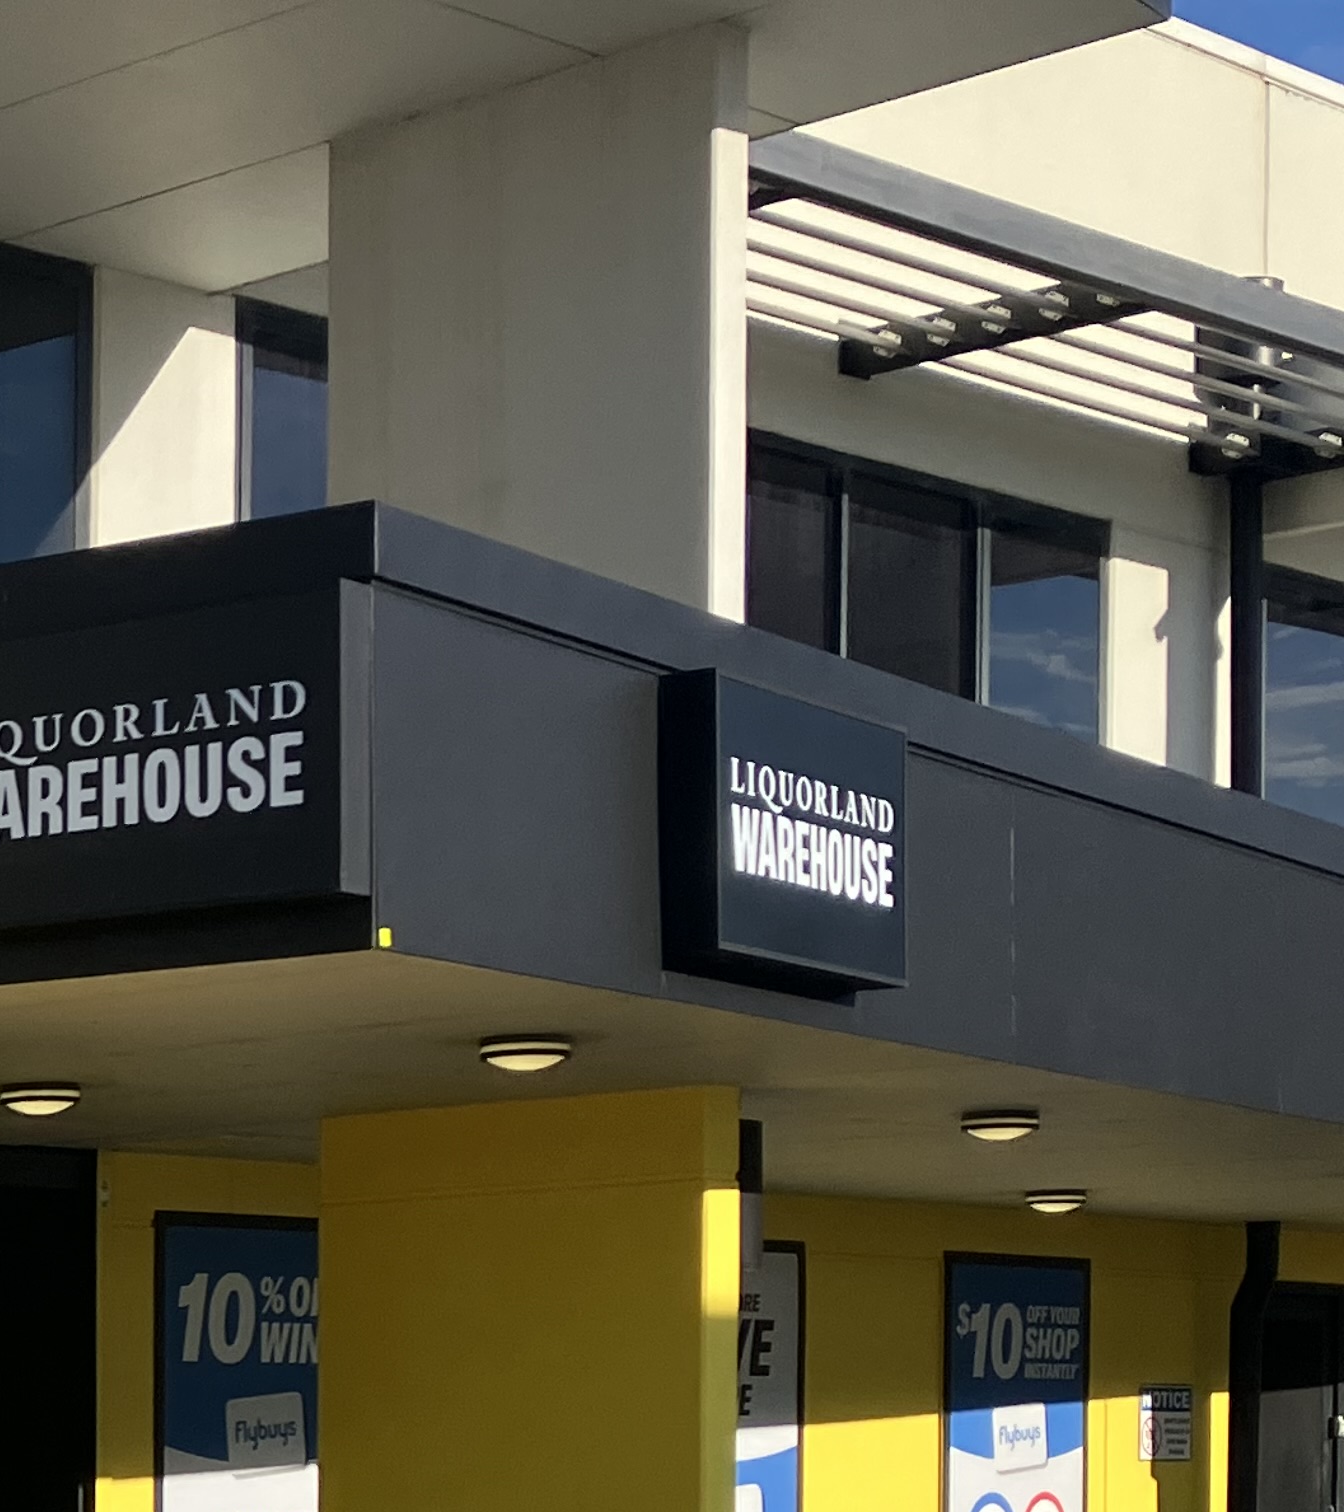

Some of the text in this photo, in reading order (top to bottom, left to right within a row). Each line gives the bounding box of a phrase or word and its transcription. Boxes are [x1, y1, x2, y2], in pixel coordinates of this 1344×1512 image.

[730, 756, 895, 813] LIQUORLAND
[731, 802, 895, 908] WAREHOUSE
[1026, 1304, 1049, 1324] OFF
[261, 1321, 319, 1364] WIN
[956, 1302, 1024, 1380] $10
[1023, 1327, 1080, 1361] SHOP
[1141, 1391, 1190, 1409] NOTICE
